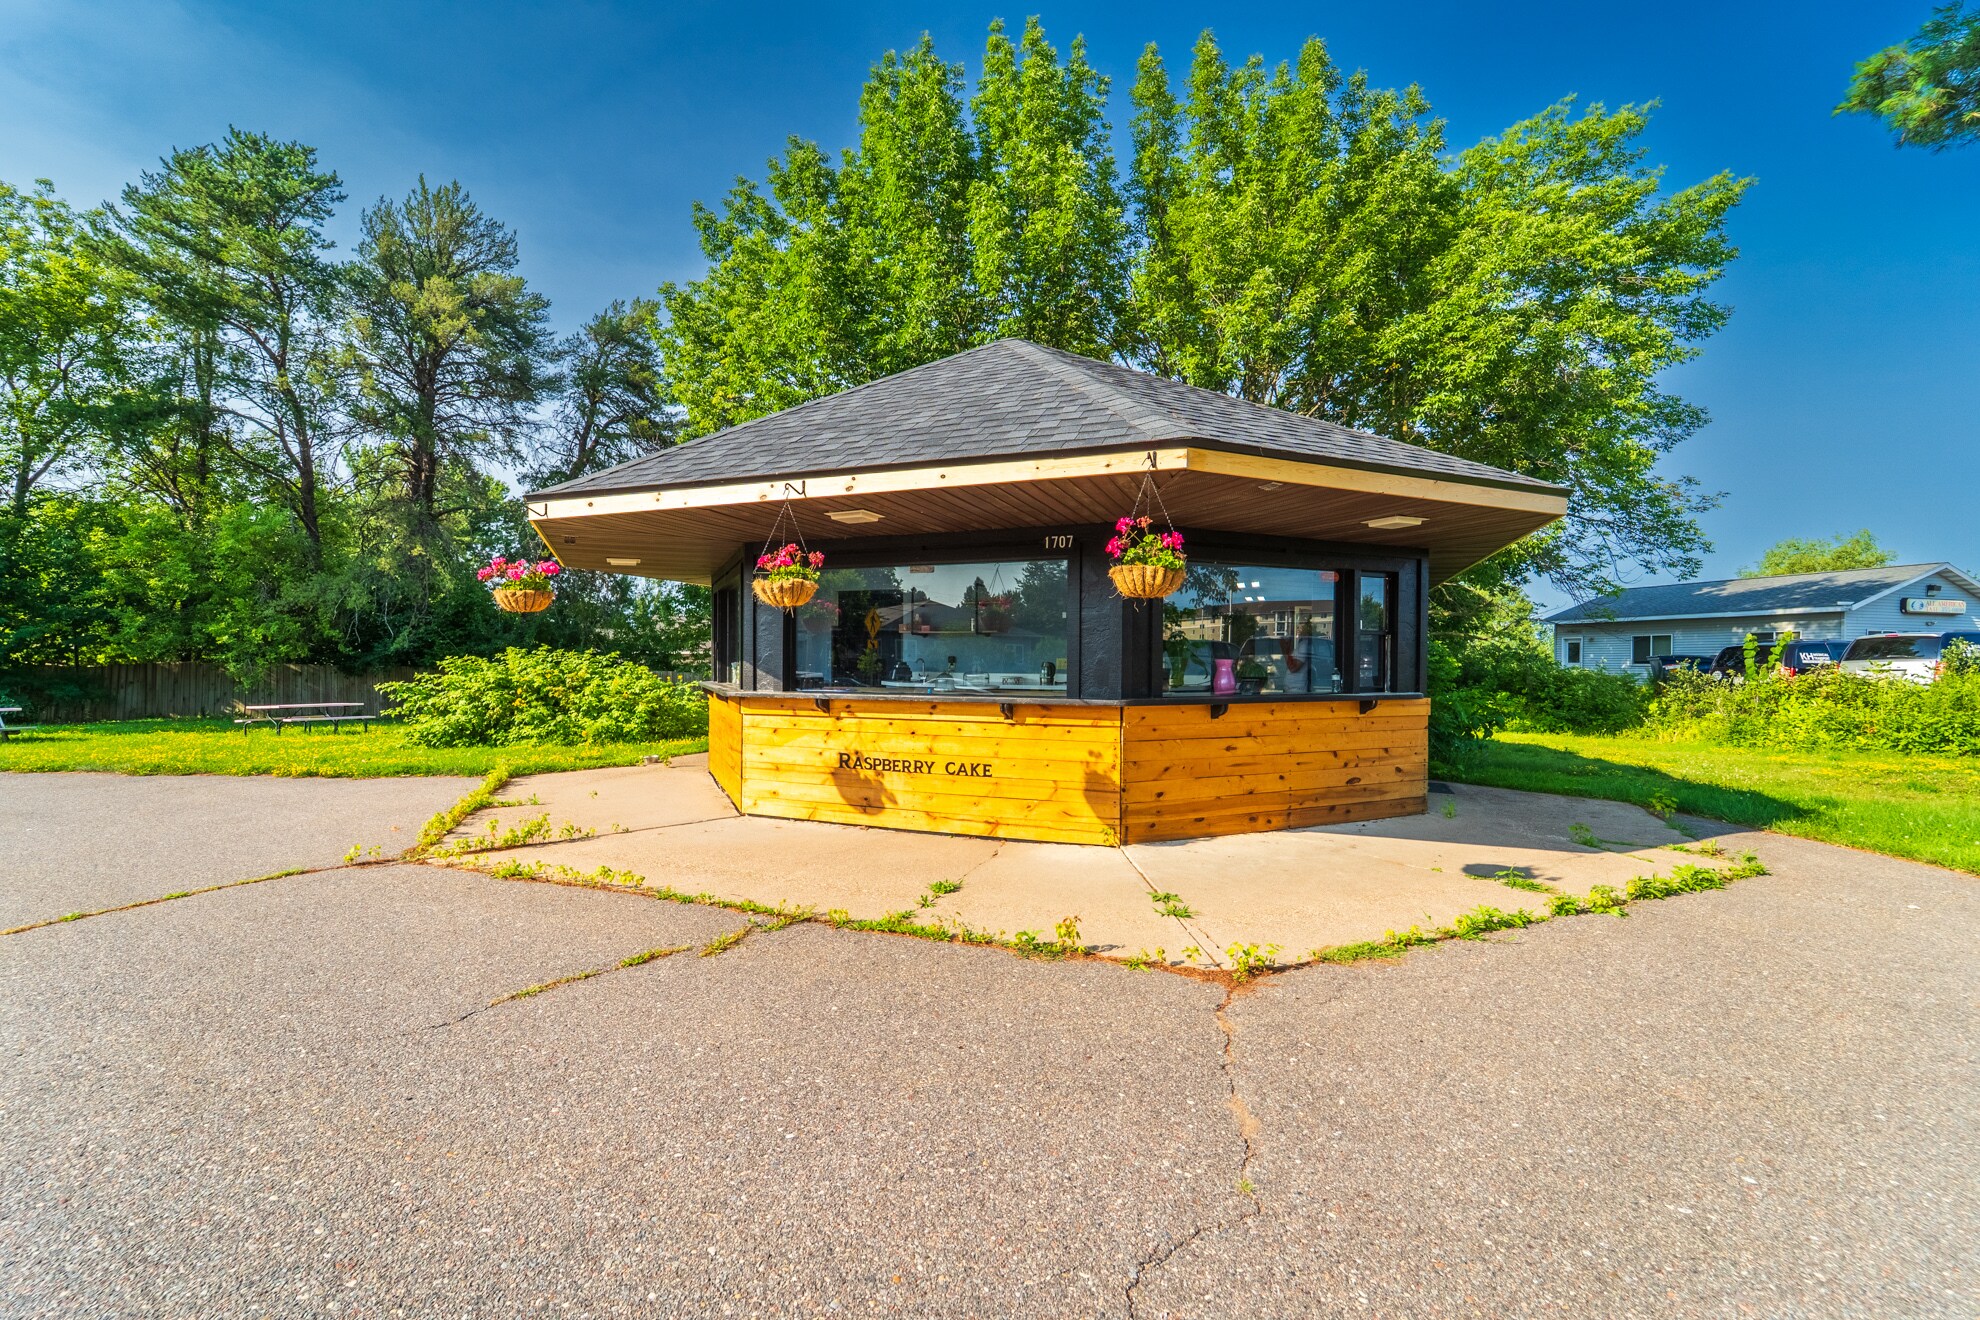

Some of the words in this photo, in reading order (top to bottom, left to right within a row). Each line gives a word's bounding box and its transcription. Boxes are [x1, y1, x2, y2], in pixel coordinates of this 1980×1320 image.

[1045, 535, 1073, 549] 1707
[838, 752, 936, 775] RASPBERRY
[944, 761, 993, 778] CAKE
